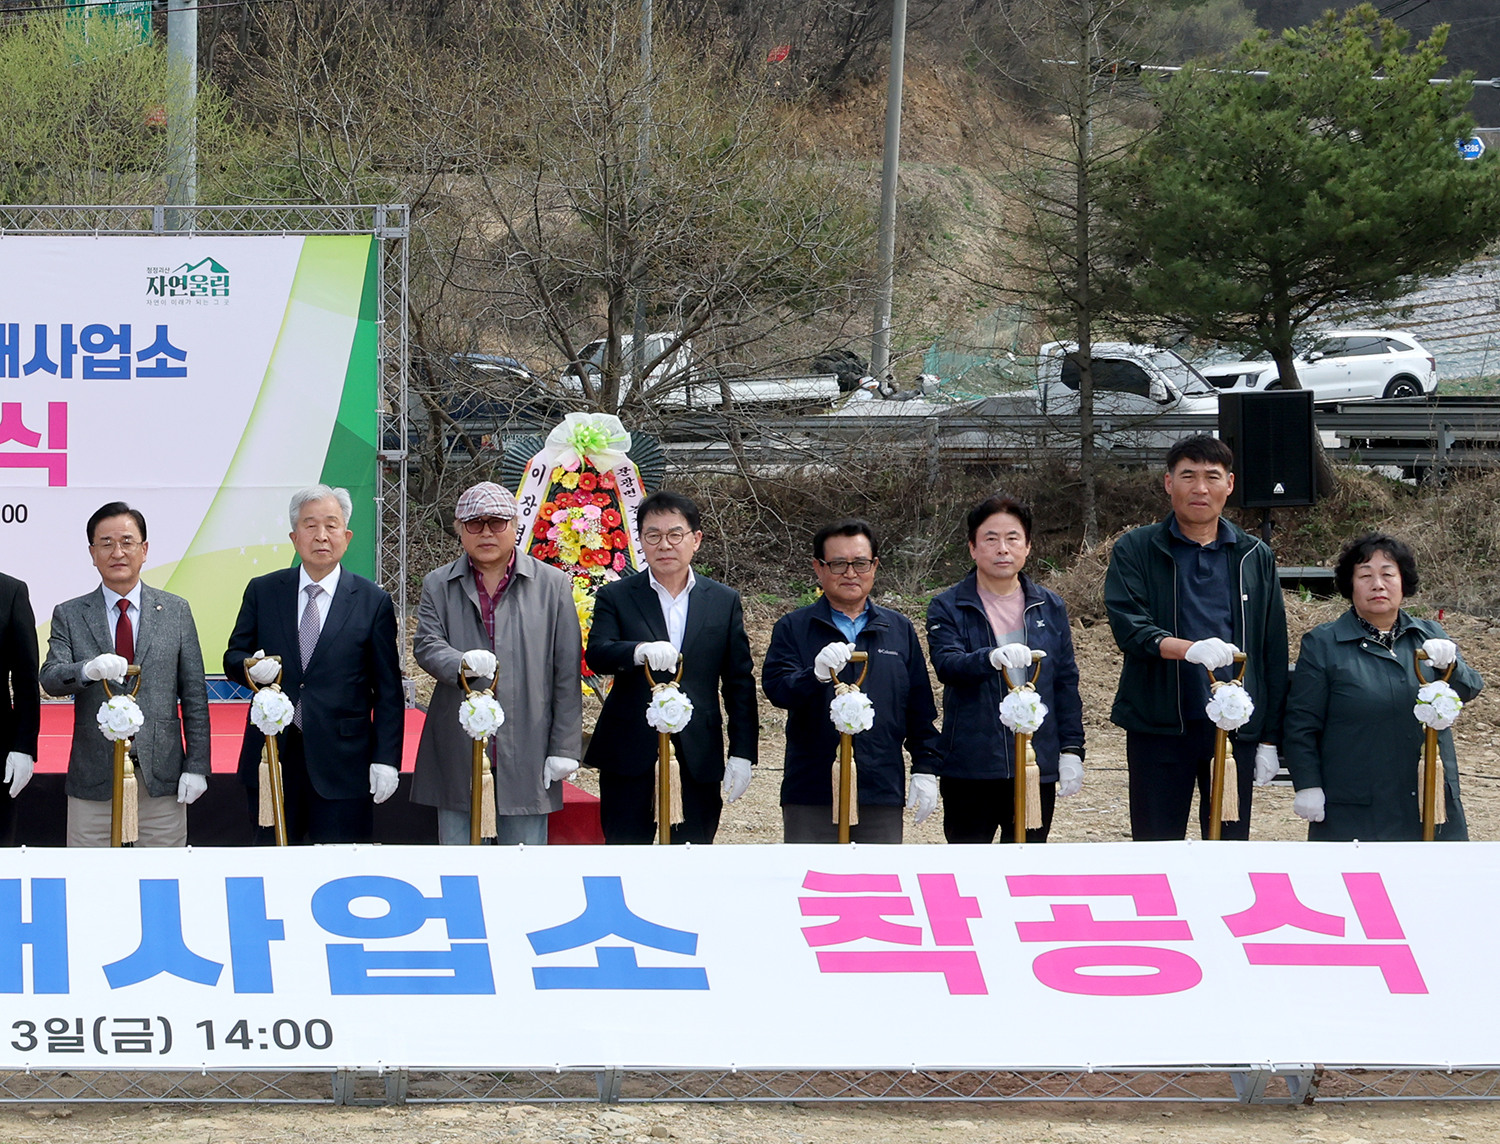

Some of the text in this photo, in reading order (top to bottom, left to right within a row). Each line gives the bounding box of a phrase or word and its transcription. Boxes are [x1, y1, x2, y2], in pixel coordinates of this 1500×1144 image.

[145, 274, 230, 297] 자연울림
[797, 870, 1429, 997] 착공식
[11, 1016, 172, 1055] 3일(금)
[196, 1019, 334, 1050] 14:00
